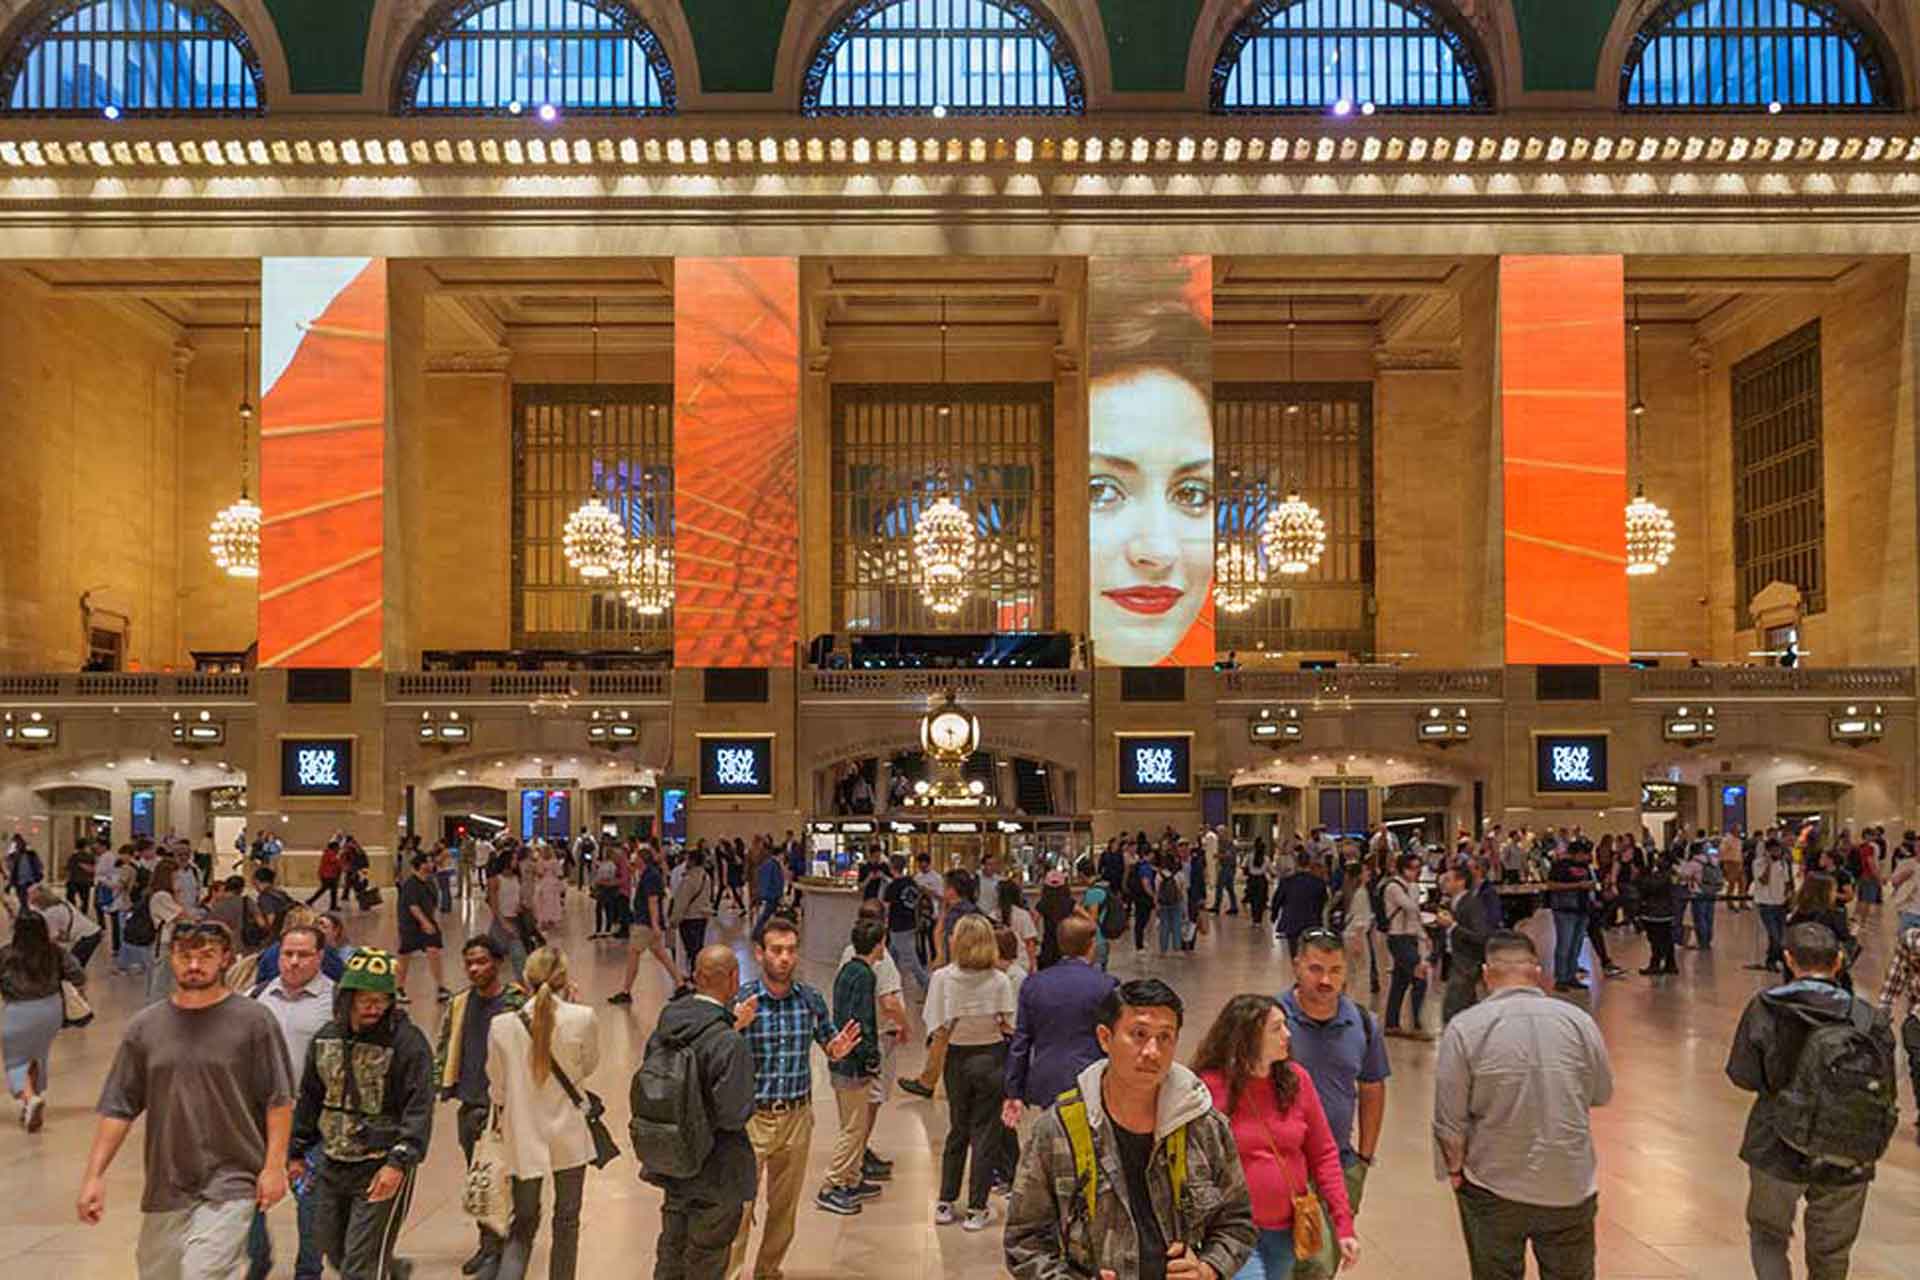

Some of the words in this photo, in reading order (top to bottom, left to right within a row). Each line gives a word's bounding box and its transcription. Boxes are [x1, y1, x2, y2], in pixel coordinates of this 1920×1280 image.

[299, 750, 335, 762] DEAR
[718, 749, 753, 761] DEAR
[1137, 748, 1172, 760] DEAR
[1553, 747, 1589, 759] DEAR
